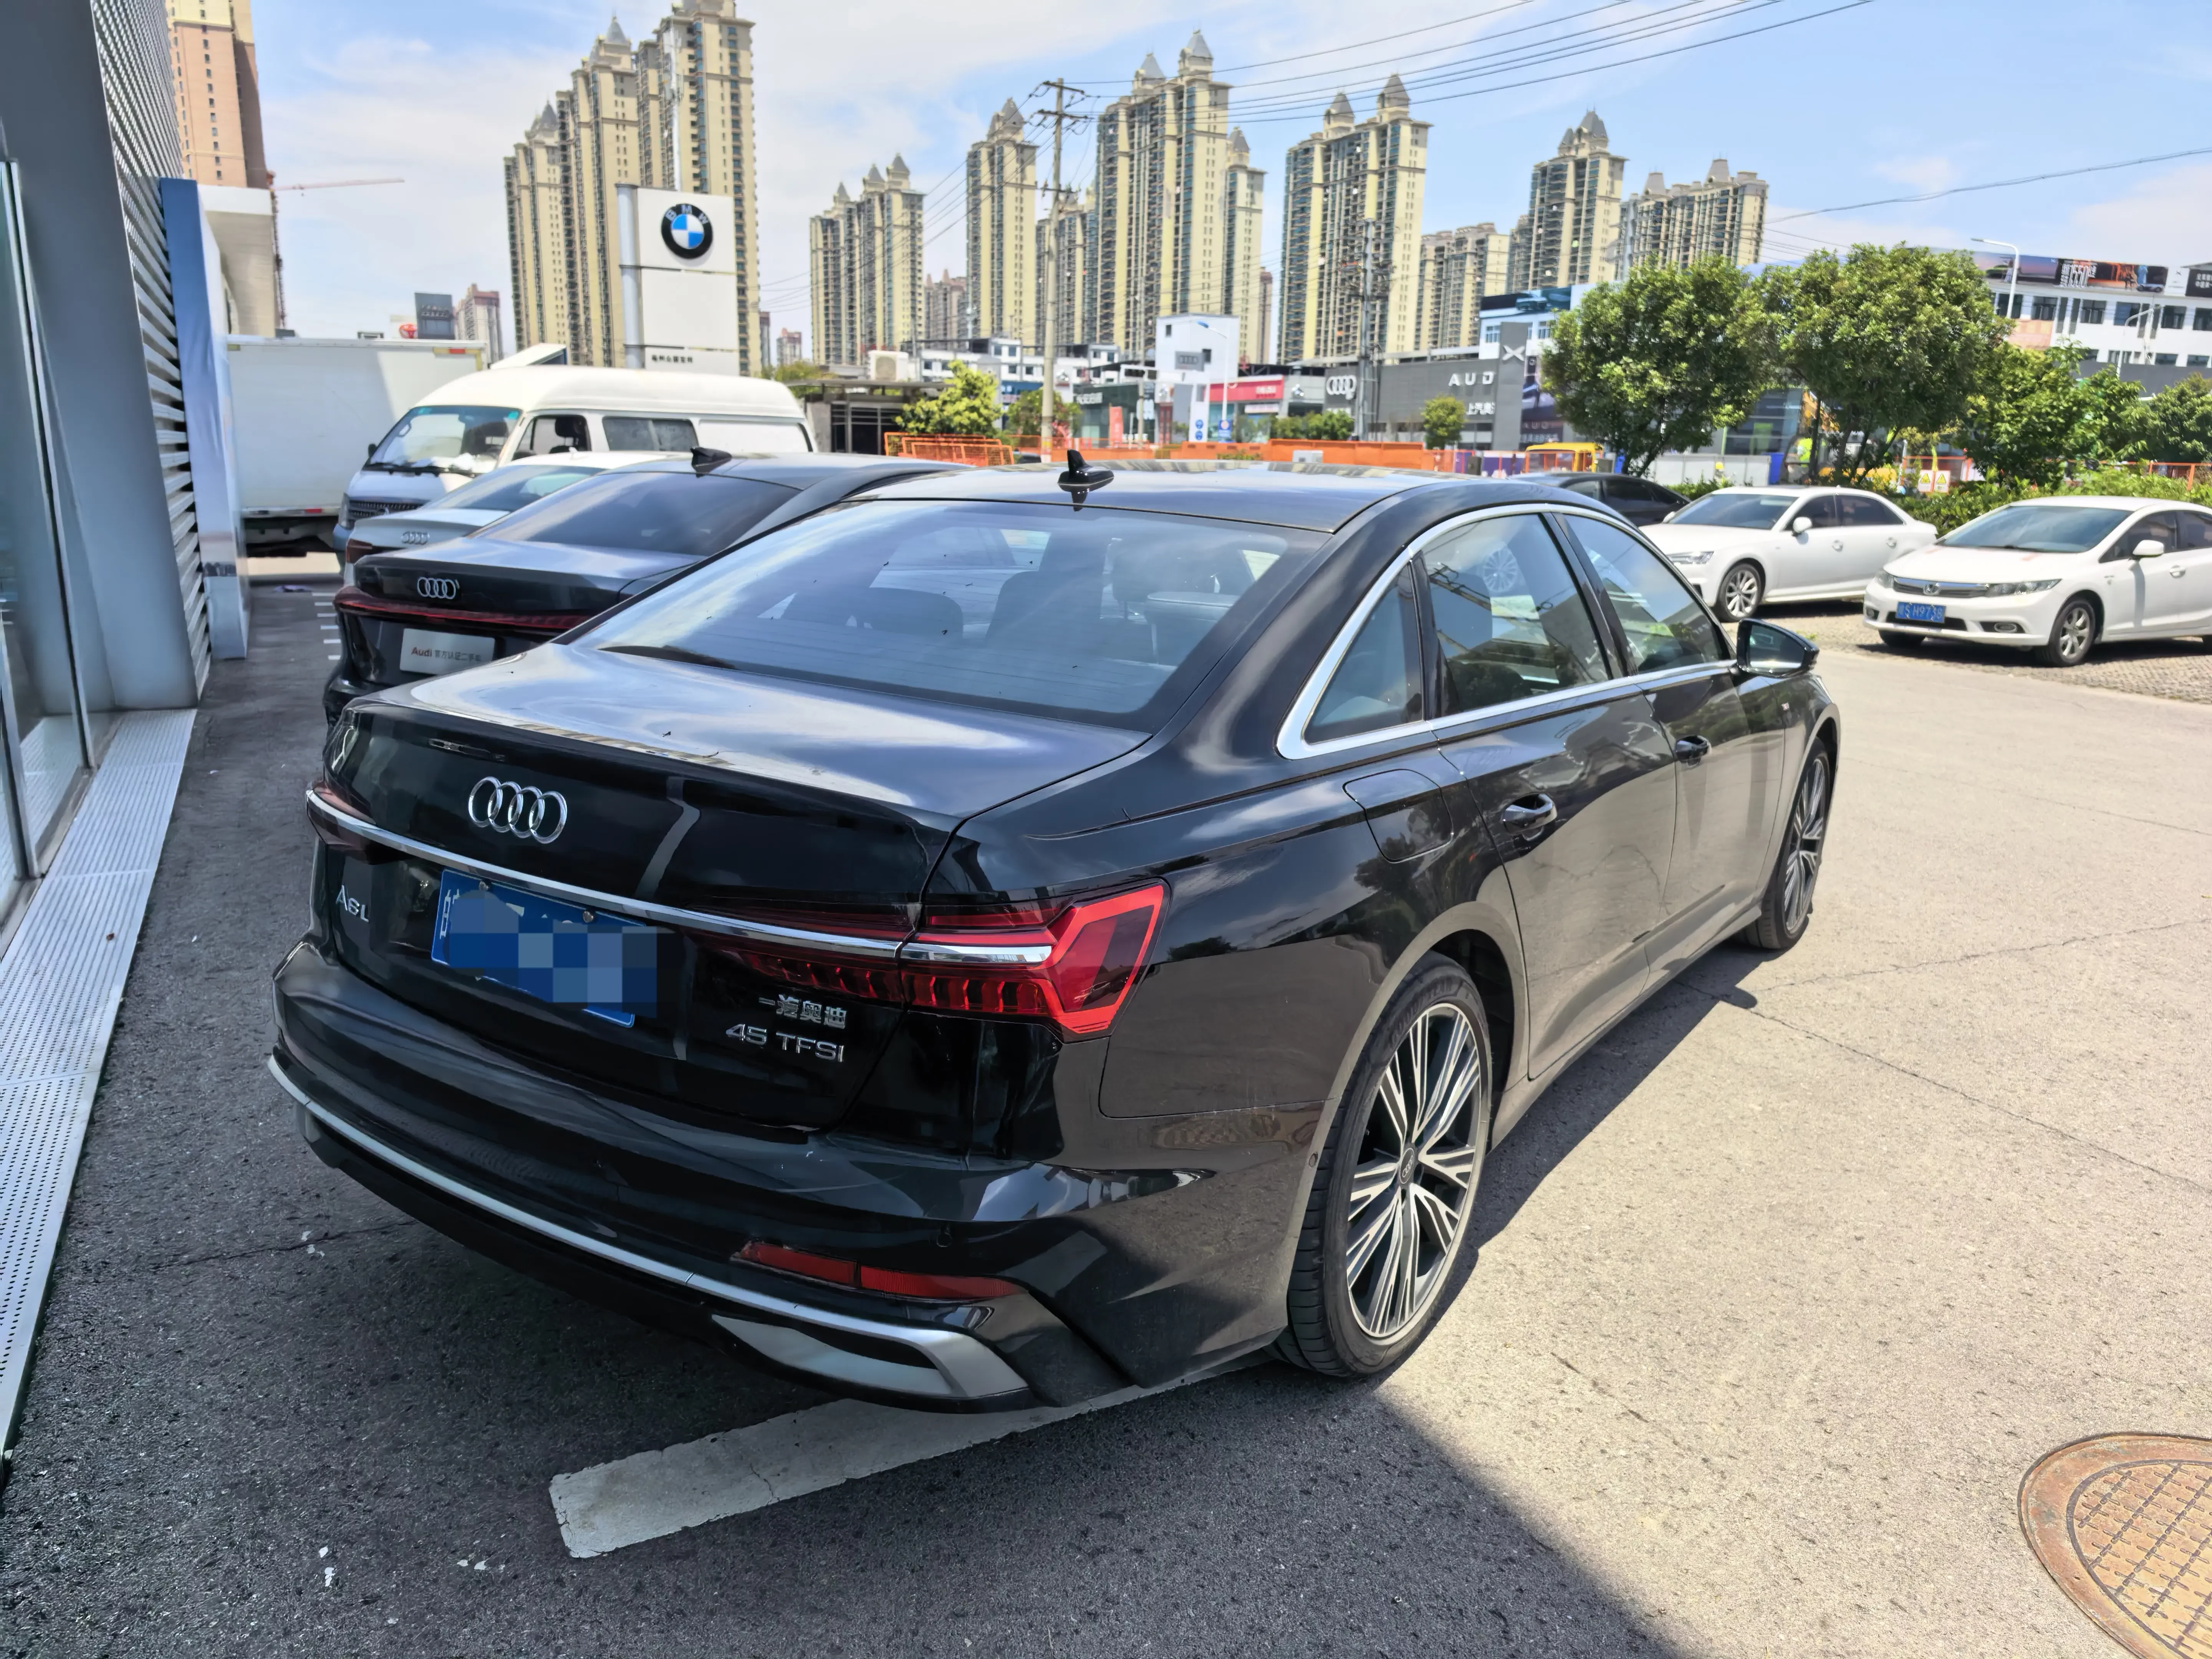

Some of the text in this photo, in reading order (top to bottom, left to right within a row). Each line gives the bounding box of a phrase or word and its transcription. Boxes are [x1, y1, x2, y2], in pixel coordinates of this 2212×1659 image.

[665, 204, 709, 225] BMW
[411, 647, 432, 658] Audi
[335, 884, 369, 922] A6L
[725, 1023, 844, 1063] 45 TFSI
